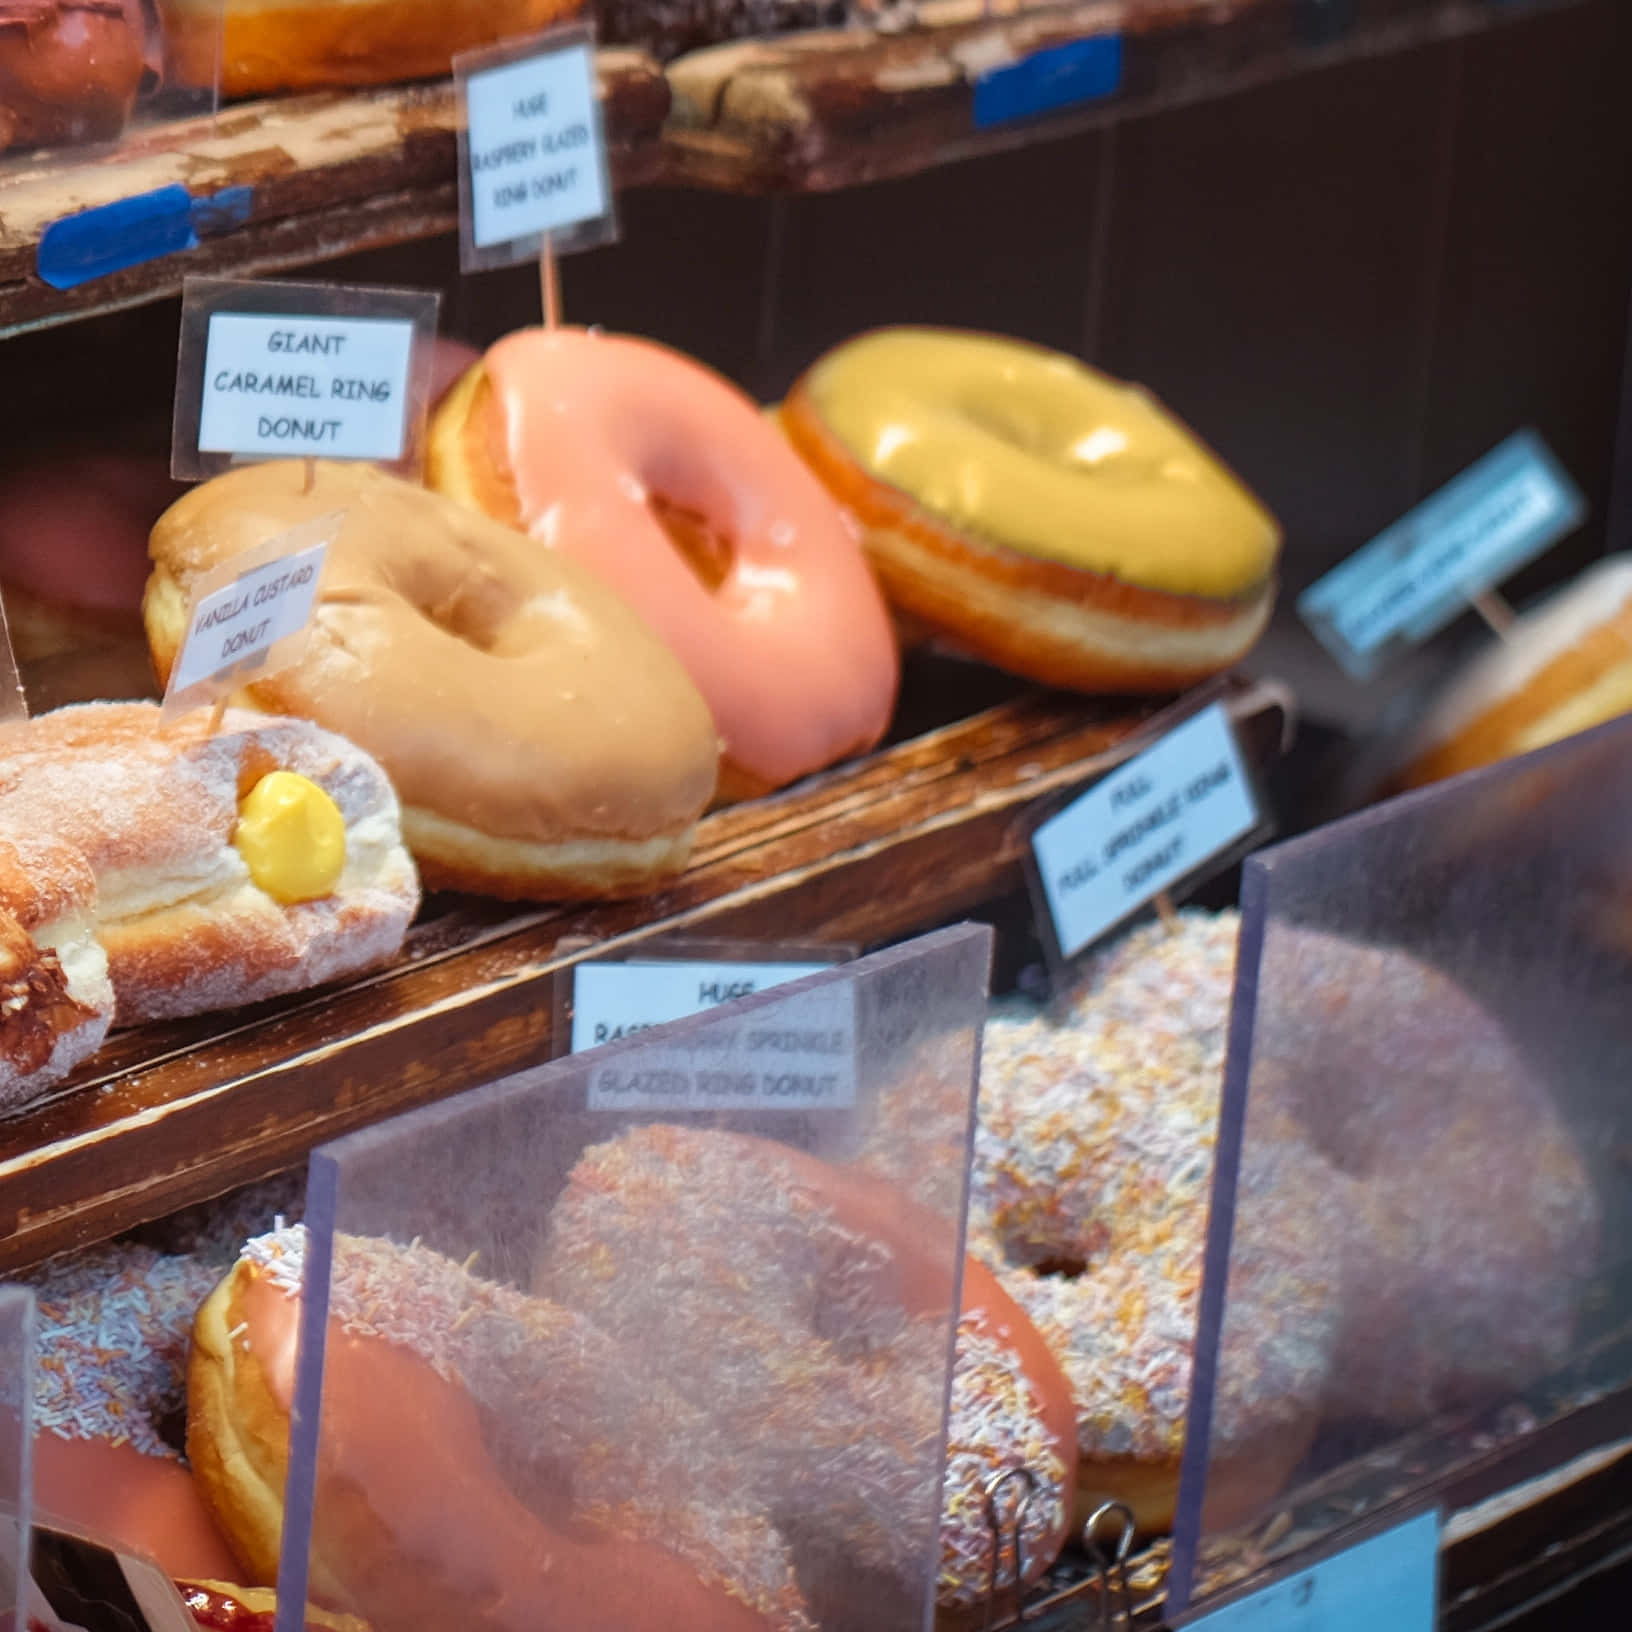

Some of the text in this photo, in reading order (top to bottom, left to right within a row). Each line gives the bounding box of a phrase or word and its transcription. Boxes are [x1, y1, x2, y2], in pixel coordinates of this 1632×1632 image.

[267, 331, 346, 355] GIANT
[214, 371, 391, 402] CARAMEL RING
[258, 417, 341, 441] DONUT
[195, 564, 314, 637] VANILLA CUSTARD
[221, 617, 271, 658] DONUT
[762, 1072, 841, 1097] DONUT
